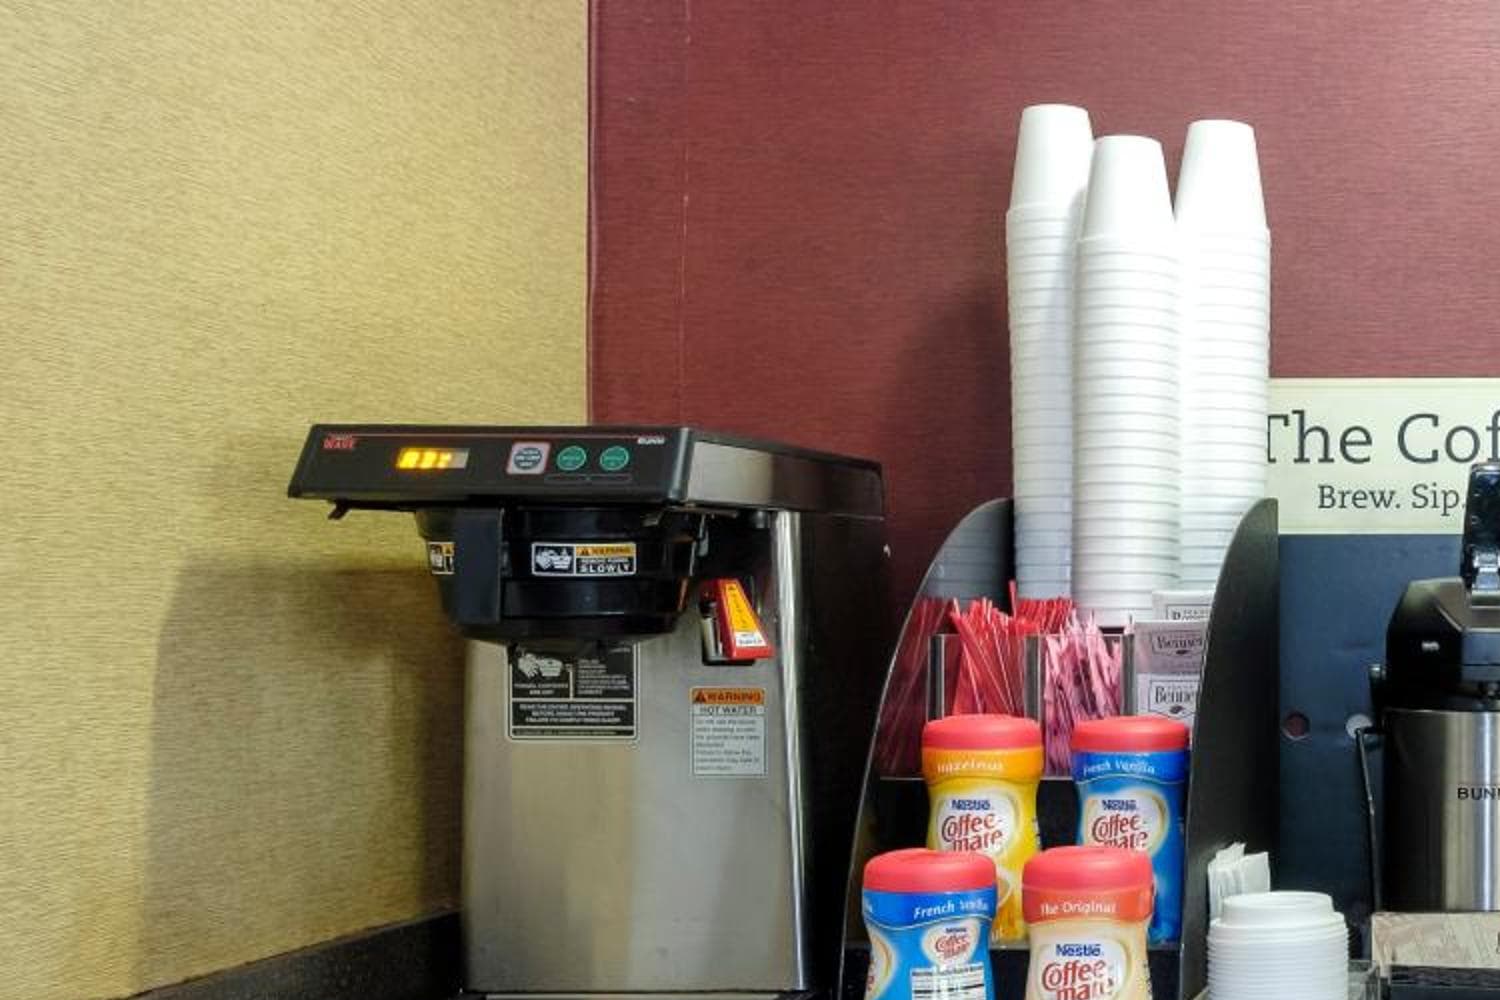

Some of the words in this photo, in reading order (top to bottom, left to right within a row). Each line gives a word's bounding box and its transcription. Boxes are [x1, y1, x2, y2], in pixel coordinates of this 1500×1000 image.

[1266, 409, 1373, 463] The
[1316, 484, 1401, 510] Brew.
[1411, 482, 1467, 517] Sip.
[912, 899, 955, 920] French
[1062, 898, 1119, 915] Original
